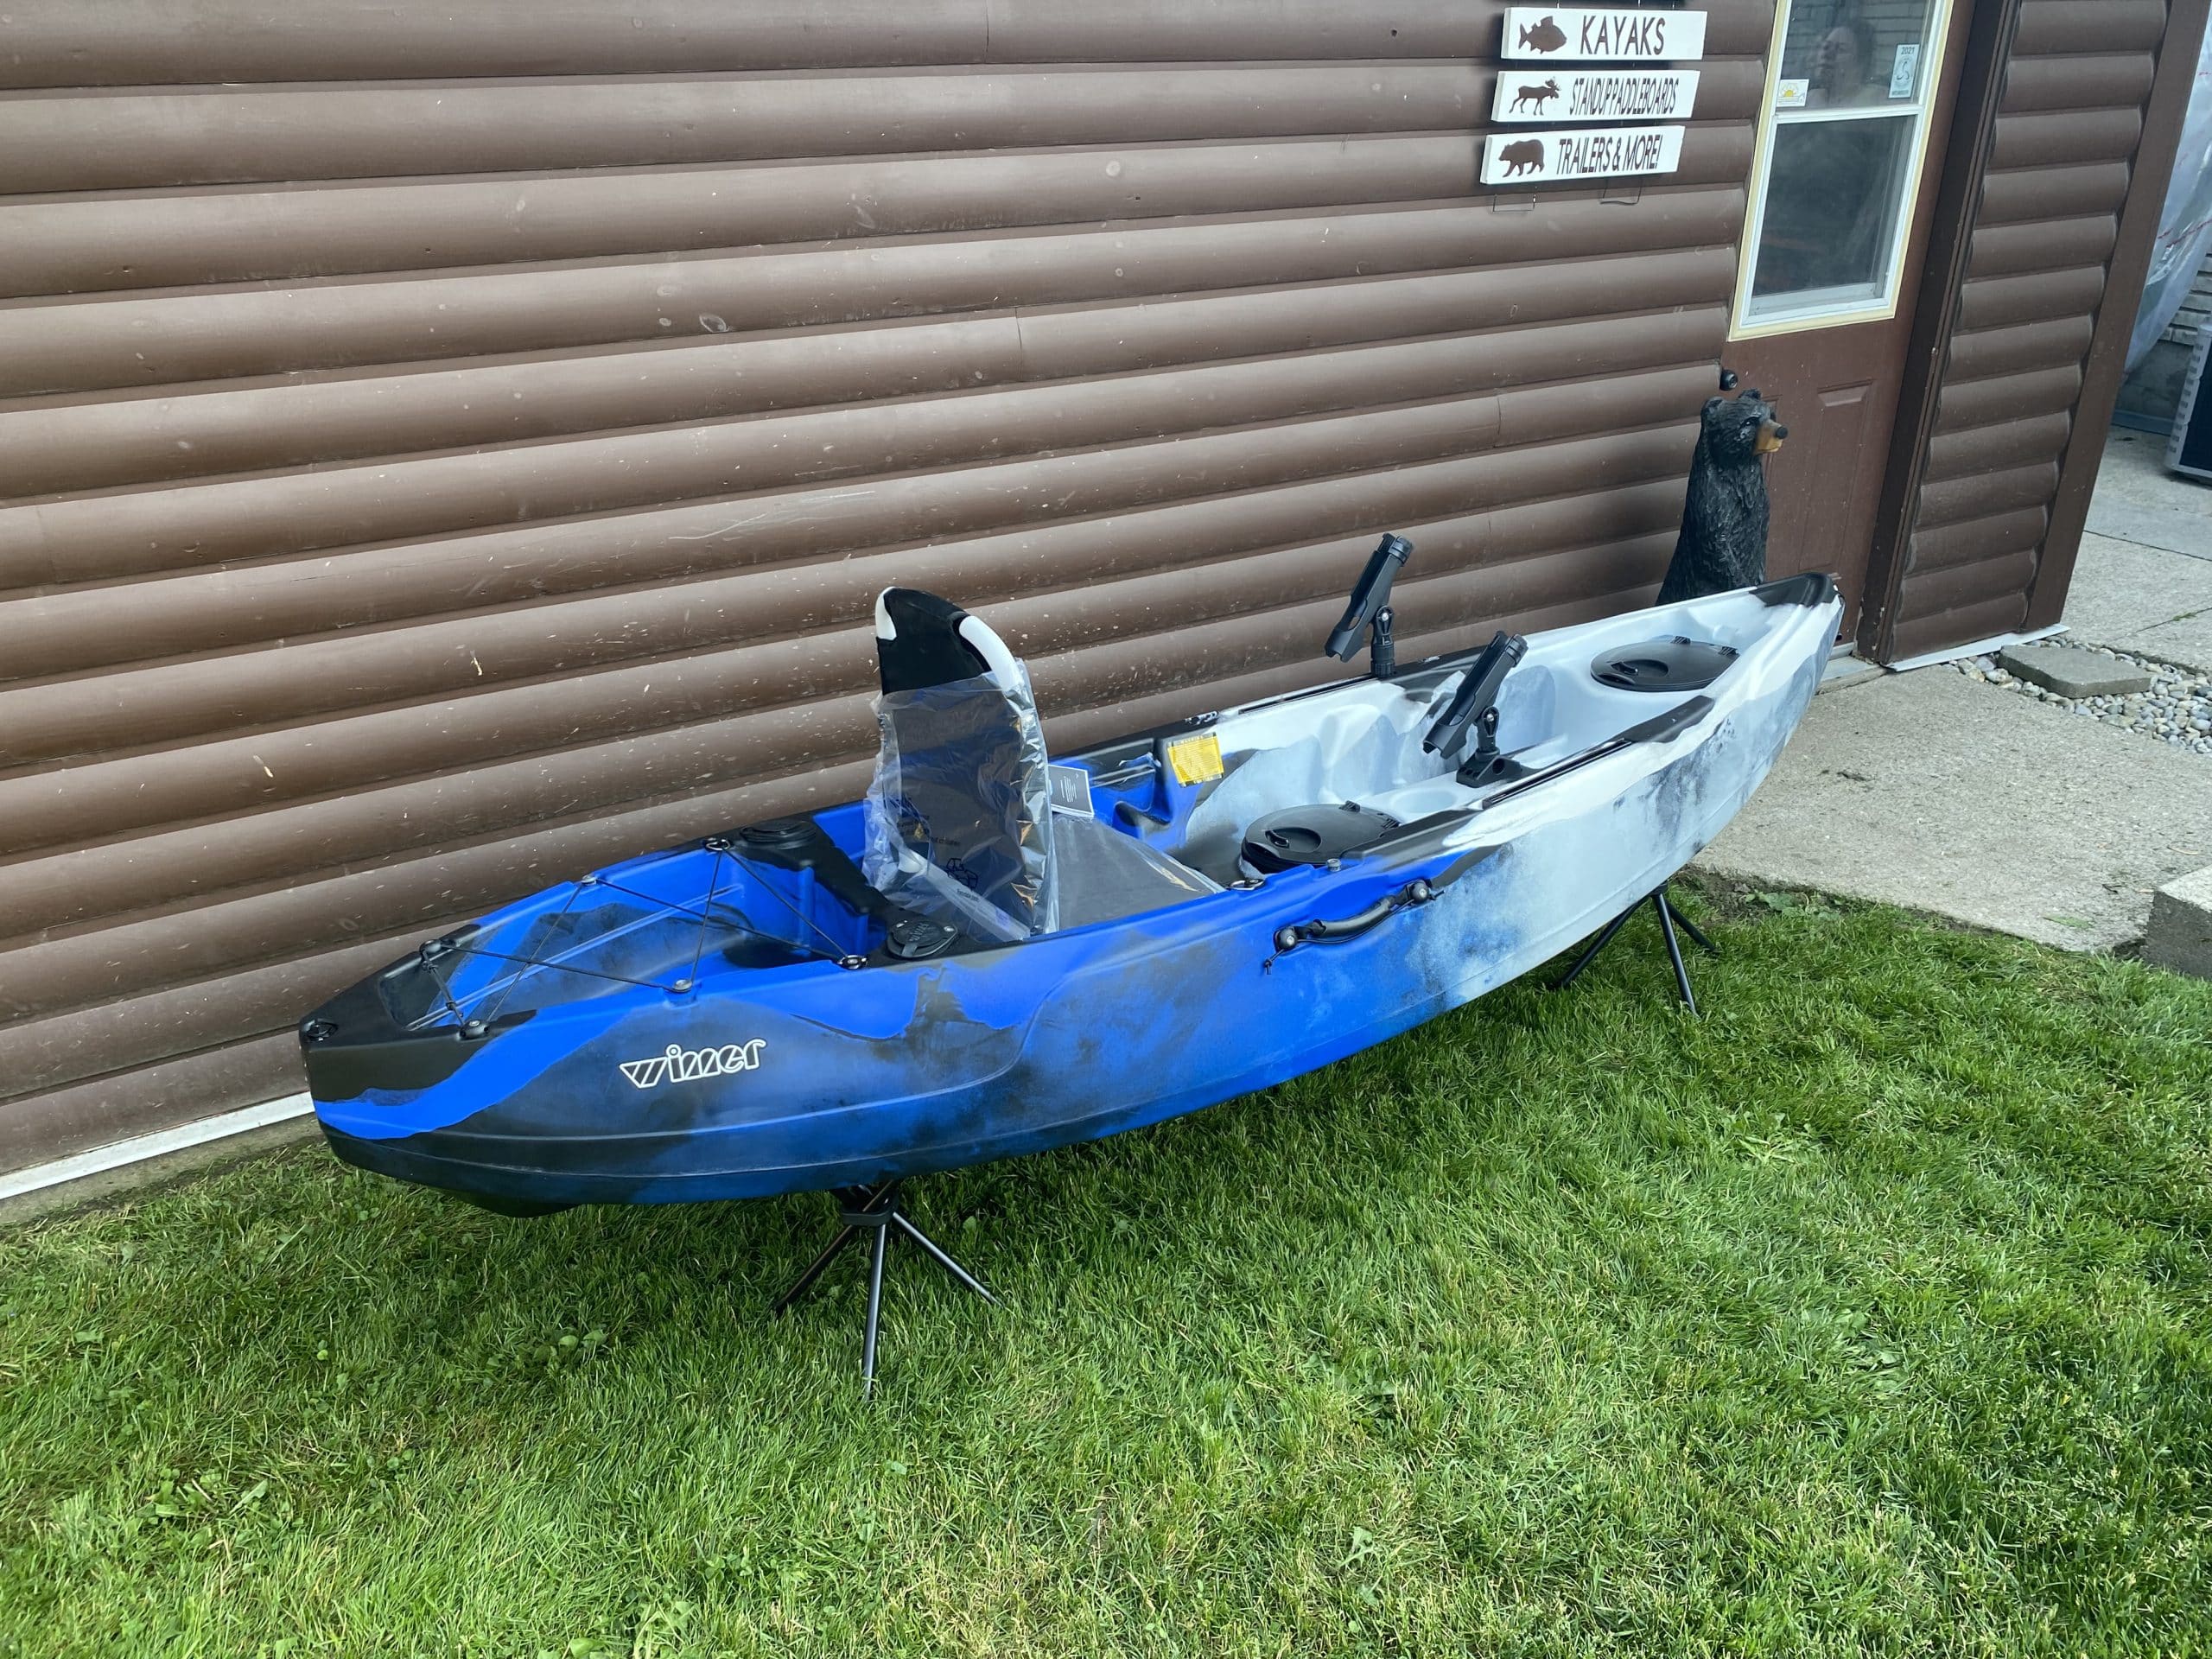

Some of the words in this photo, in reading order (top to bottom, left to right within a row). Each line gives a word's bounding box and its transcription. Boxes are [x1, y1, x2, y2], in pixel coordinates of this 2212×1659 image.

[1580, 16, 1665, 55] KAYAKS
[1556, 137, 1613, 174] TRAILERS
[1612, 137, 1620, 170] &
[1622, 135, 1663, 172] MORE!
